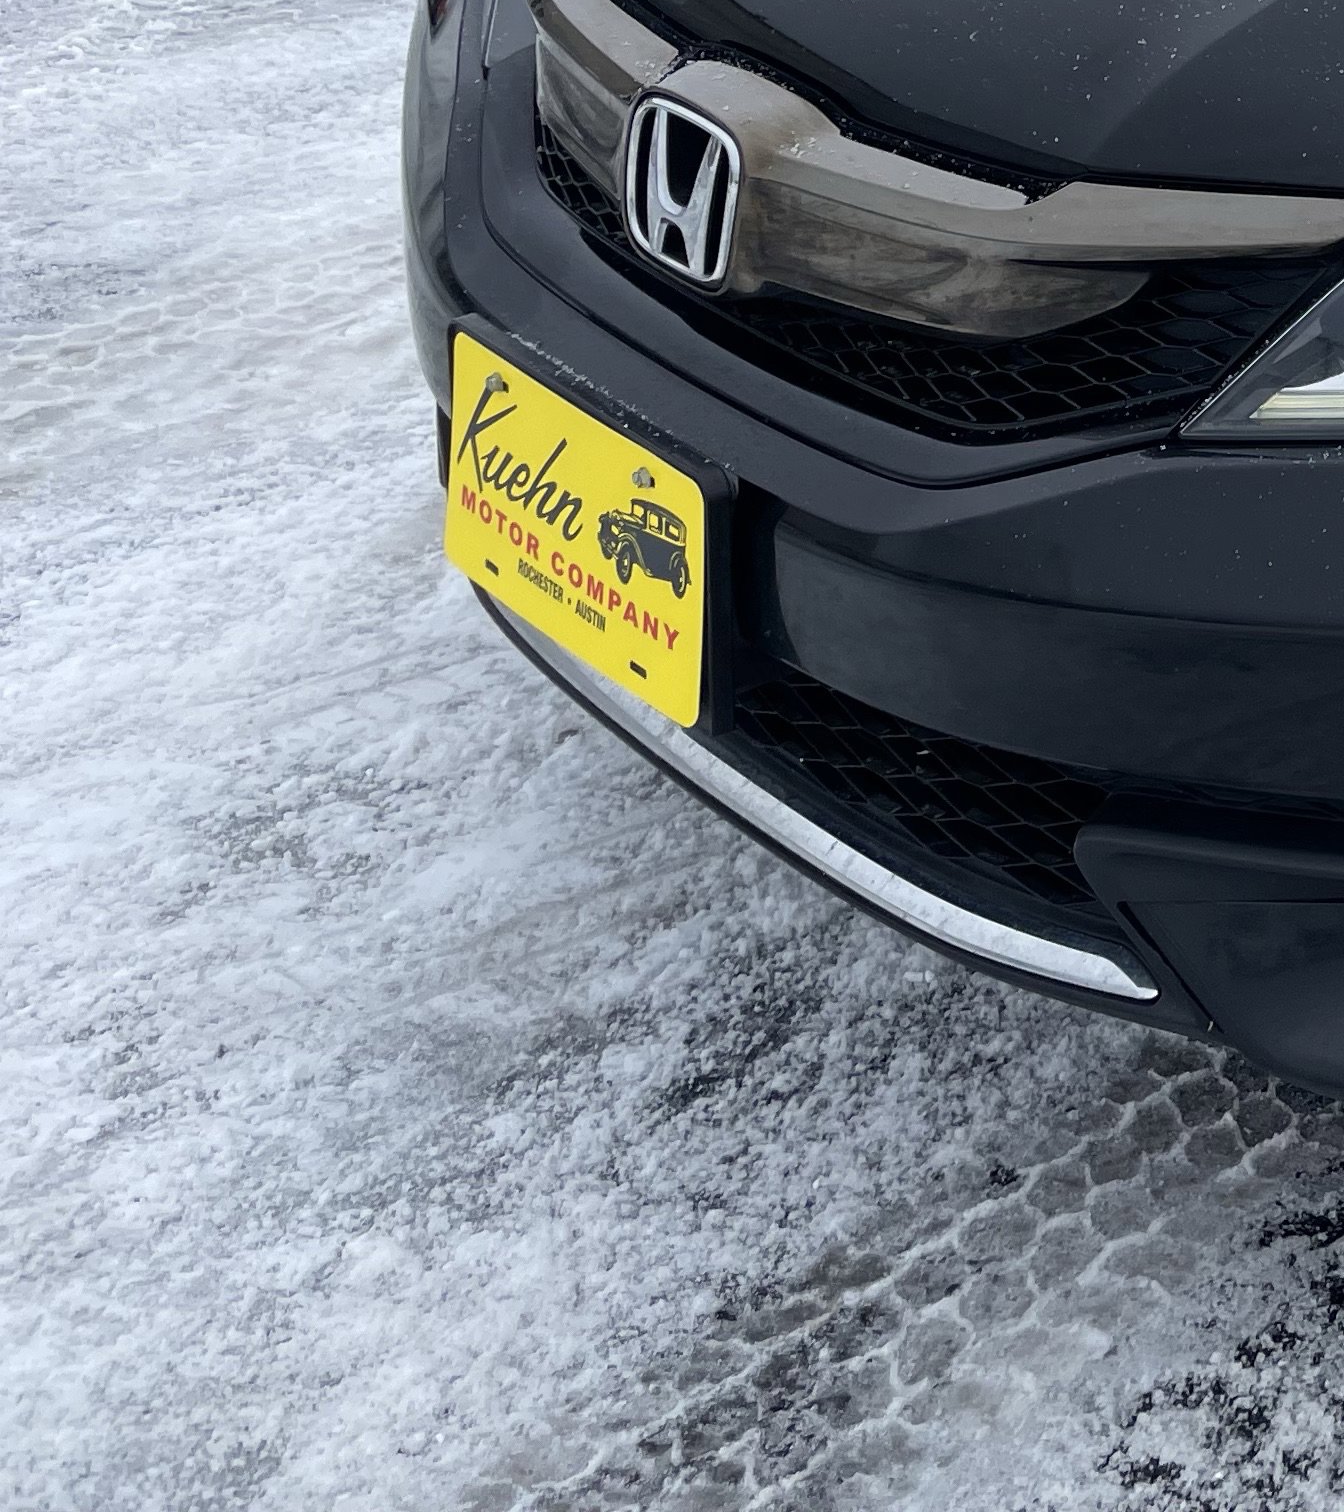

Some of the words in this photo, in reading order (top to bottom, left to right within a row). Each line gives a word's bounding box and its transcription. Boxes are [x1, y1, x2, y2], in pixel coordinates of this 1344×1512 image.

[457, 385, 583, 542] Kuehn
[461, 483, 540, 561] MOTOR
[551, 550, 680, 651] COMPANY
[518, 557, 564, 604] ROCHESTER
[575, 599, 607, 632] AUSTIN
